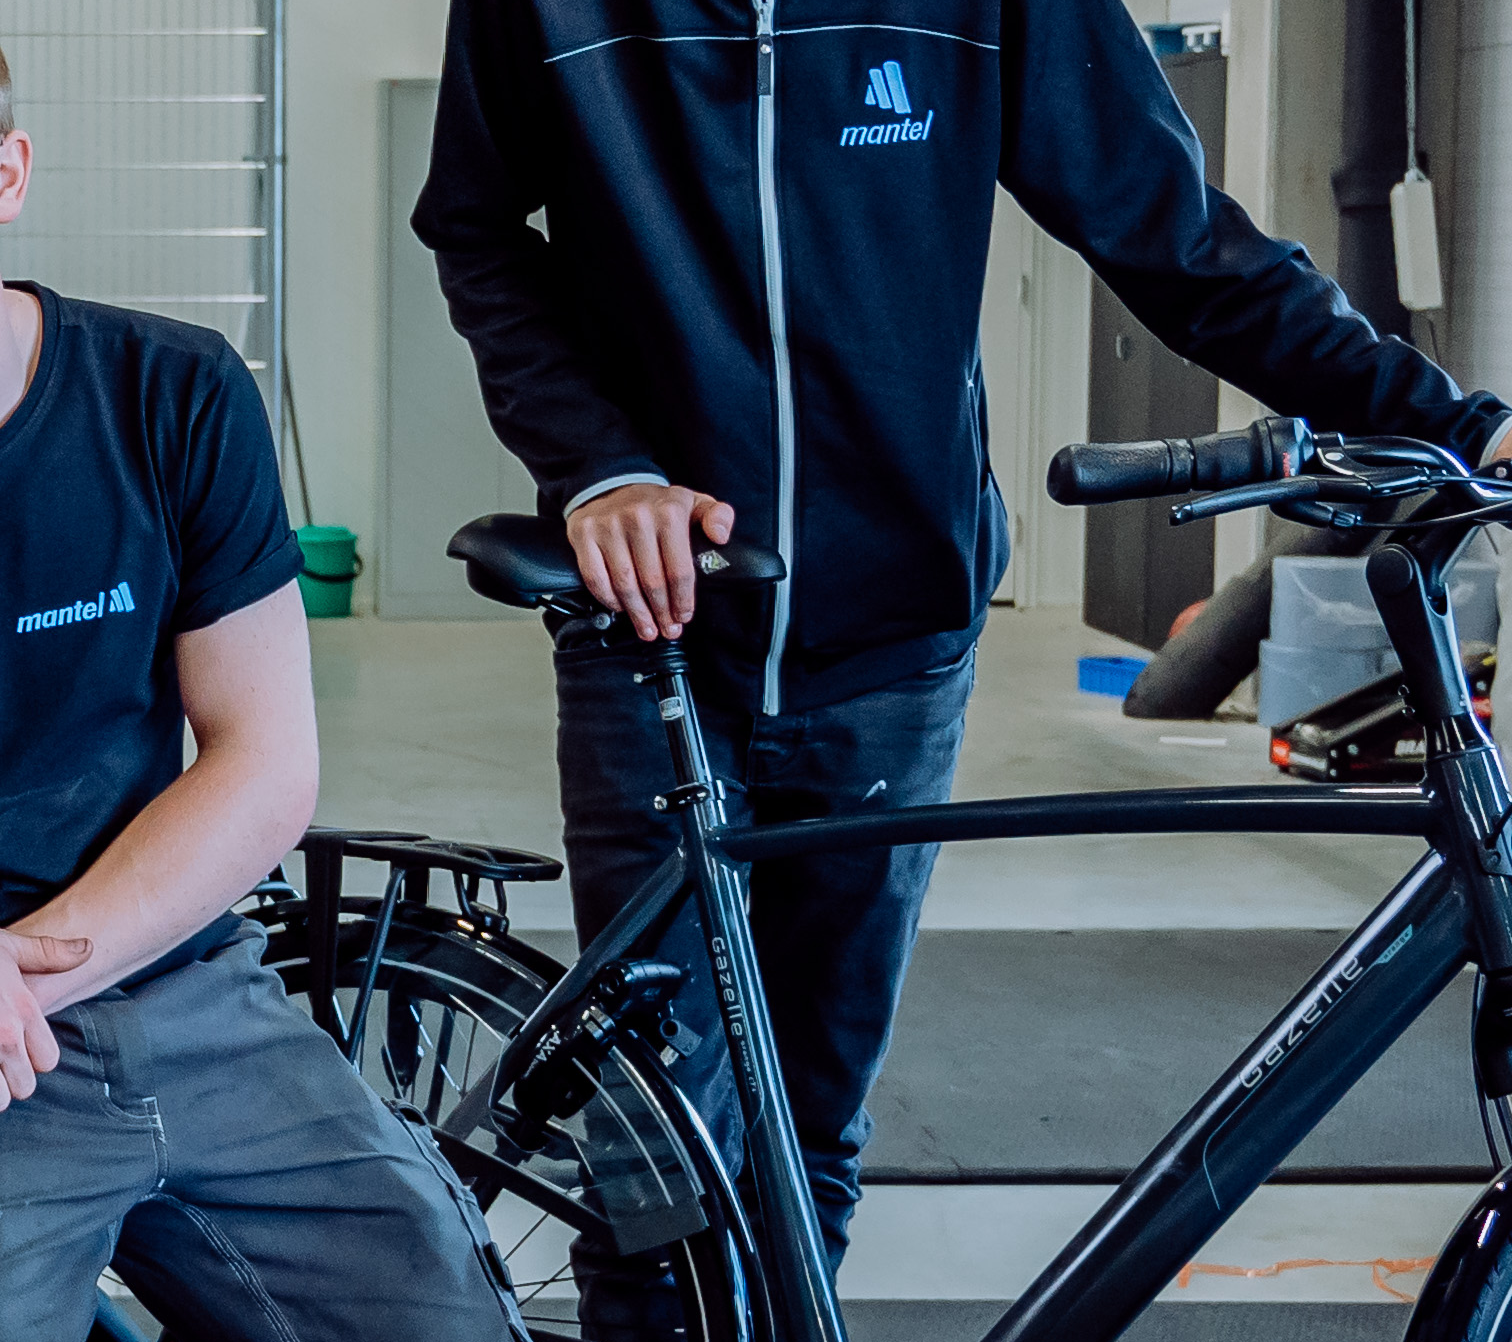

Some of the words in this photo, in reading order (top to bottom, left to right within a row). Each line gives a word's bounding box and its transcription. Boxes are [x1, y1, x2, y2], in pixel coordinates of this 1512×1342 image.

[840, 109, 934, 146] mantel
[17, 591, 106, 633] mantel
[712, 936, 744, 1037] Gazelle
[1239, 956, 1364, 1089] Gazelle
